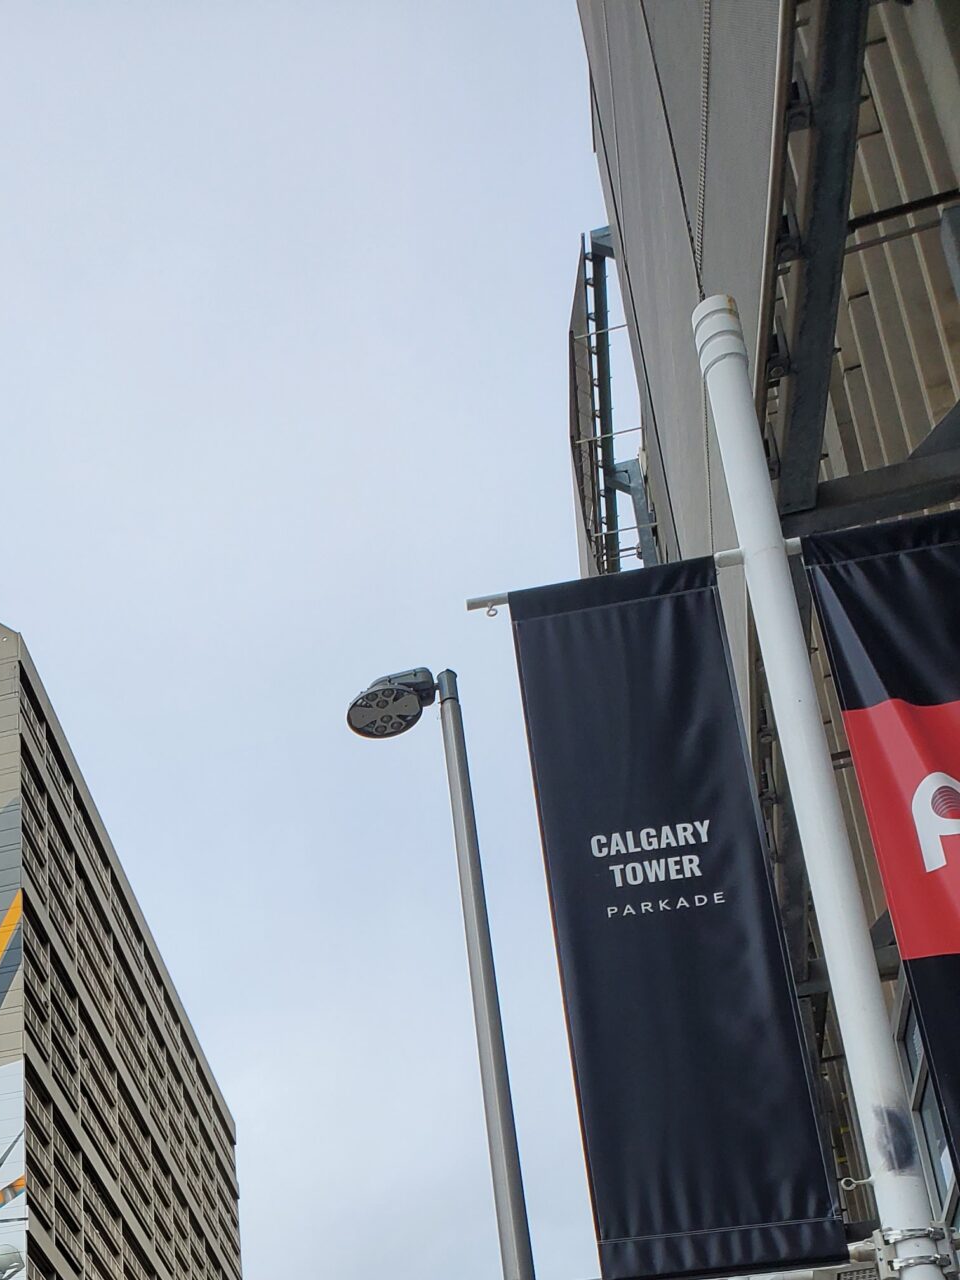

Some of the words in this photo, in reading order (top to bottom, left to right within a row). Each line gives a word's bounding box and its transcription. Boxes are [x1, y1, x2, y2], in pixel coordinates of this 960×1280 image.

[590, 819, 710, 858] CALGARY
[609, 854, 702, 888] TOWER
[606, 891, 726, 918] PARKADE
